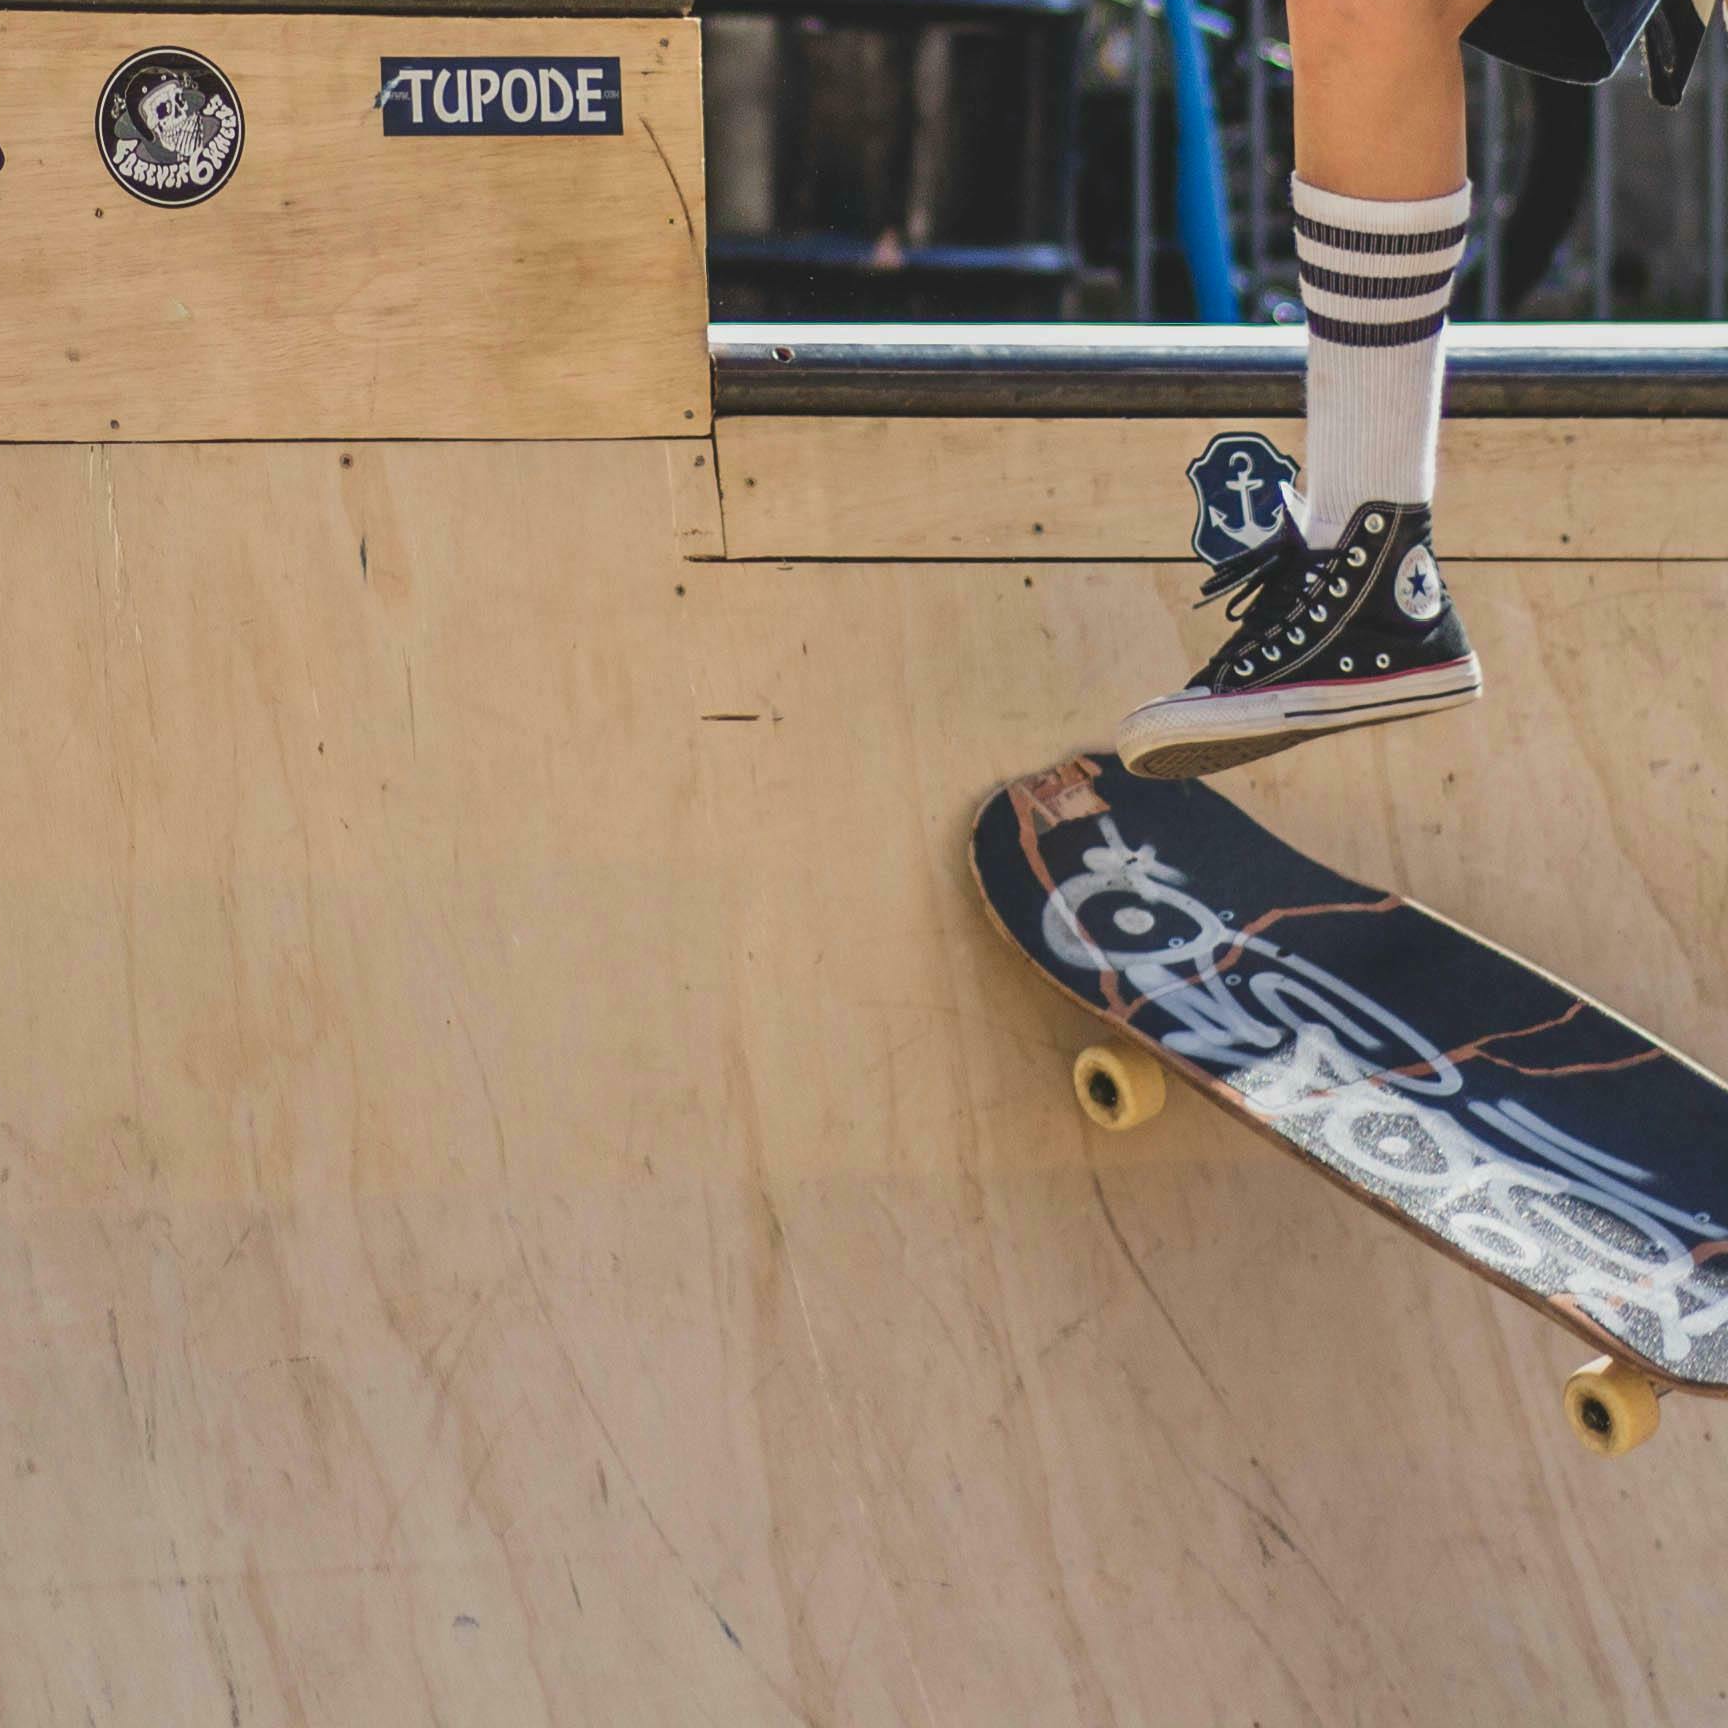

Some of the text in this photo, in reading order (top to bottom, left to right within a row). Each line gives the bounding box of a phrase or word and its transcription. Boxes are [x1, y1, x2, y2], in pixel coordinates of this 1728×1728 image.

[398, 68, 607, 123] TUPODE
[113, 94, 237, 190] FOREVER 6 WHEELS
